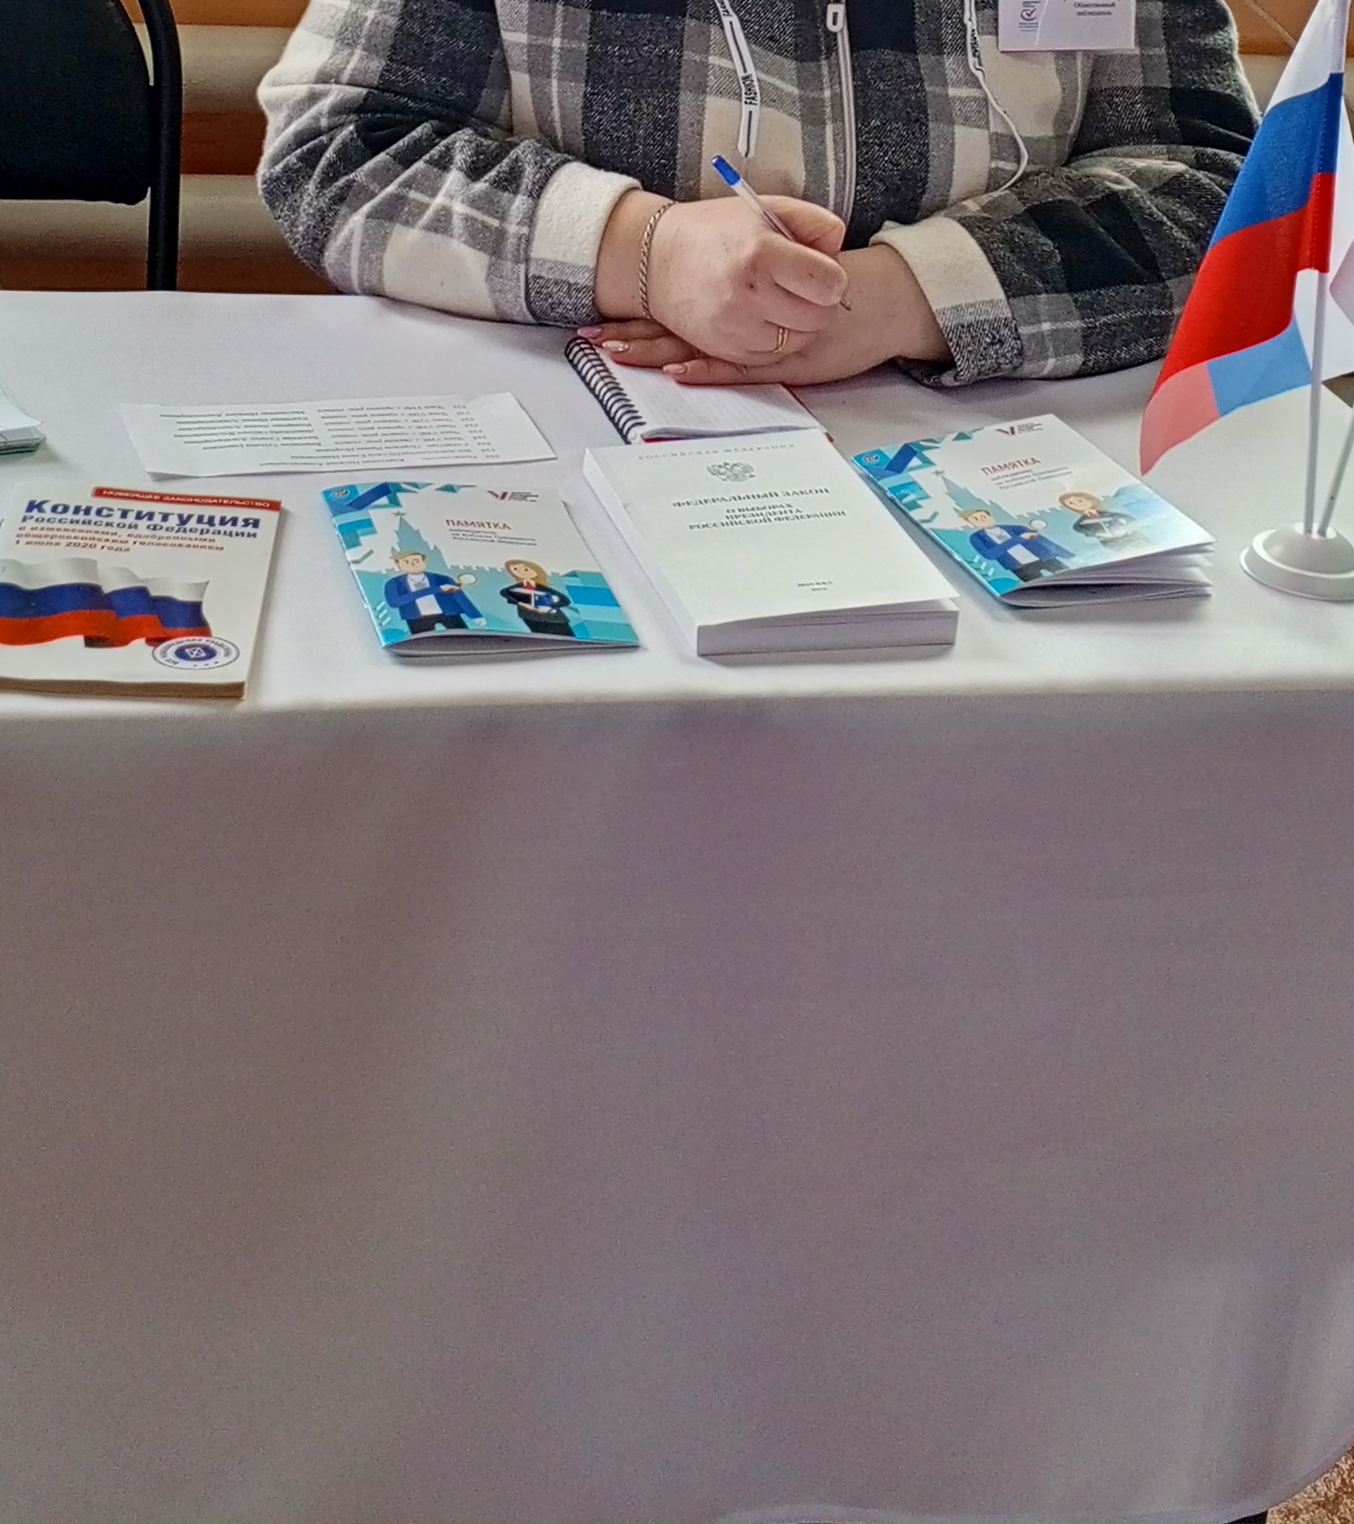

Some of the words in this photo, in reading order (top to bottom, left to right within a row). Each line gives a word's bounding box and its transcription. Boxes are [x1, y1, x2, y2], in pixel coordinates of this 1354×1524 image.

[981, 457, 1042, 476] ПАМЯТКА
[162, 495, 271, 508] ЗАКОНОДАТЕЛЬСТВО
[672, 490, 780, 508] ФЕДЕРАЛЬНЫЙ
[781, 487, 830, 498] ЗАКОН
[25, 499, 261, 529] Конституция
[21, 515, 139, 530] Российской
[146, 523, 258, 539] Федерации
[446, 519, 512, 531] ПАМЯТКА
[689, 516, 772, 530] РОССИЙСКОЙ
[65, 541, 98, 550] 2020
[99, 545, 131, 553] года
